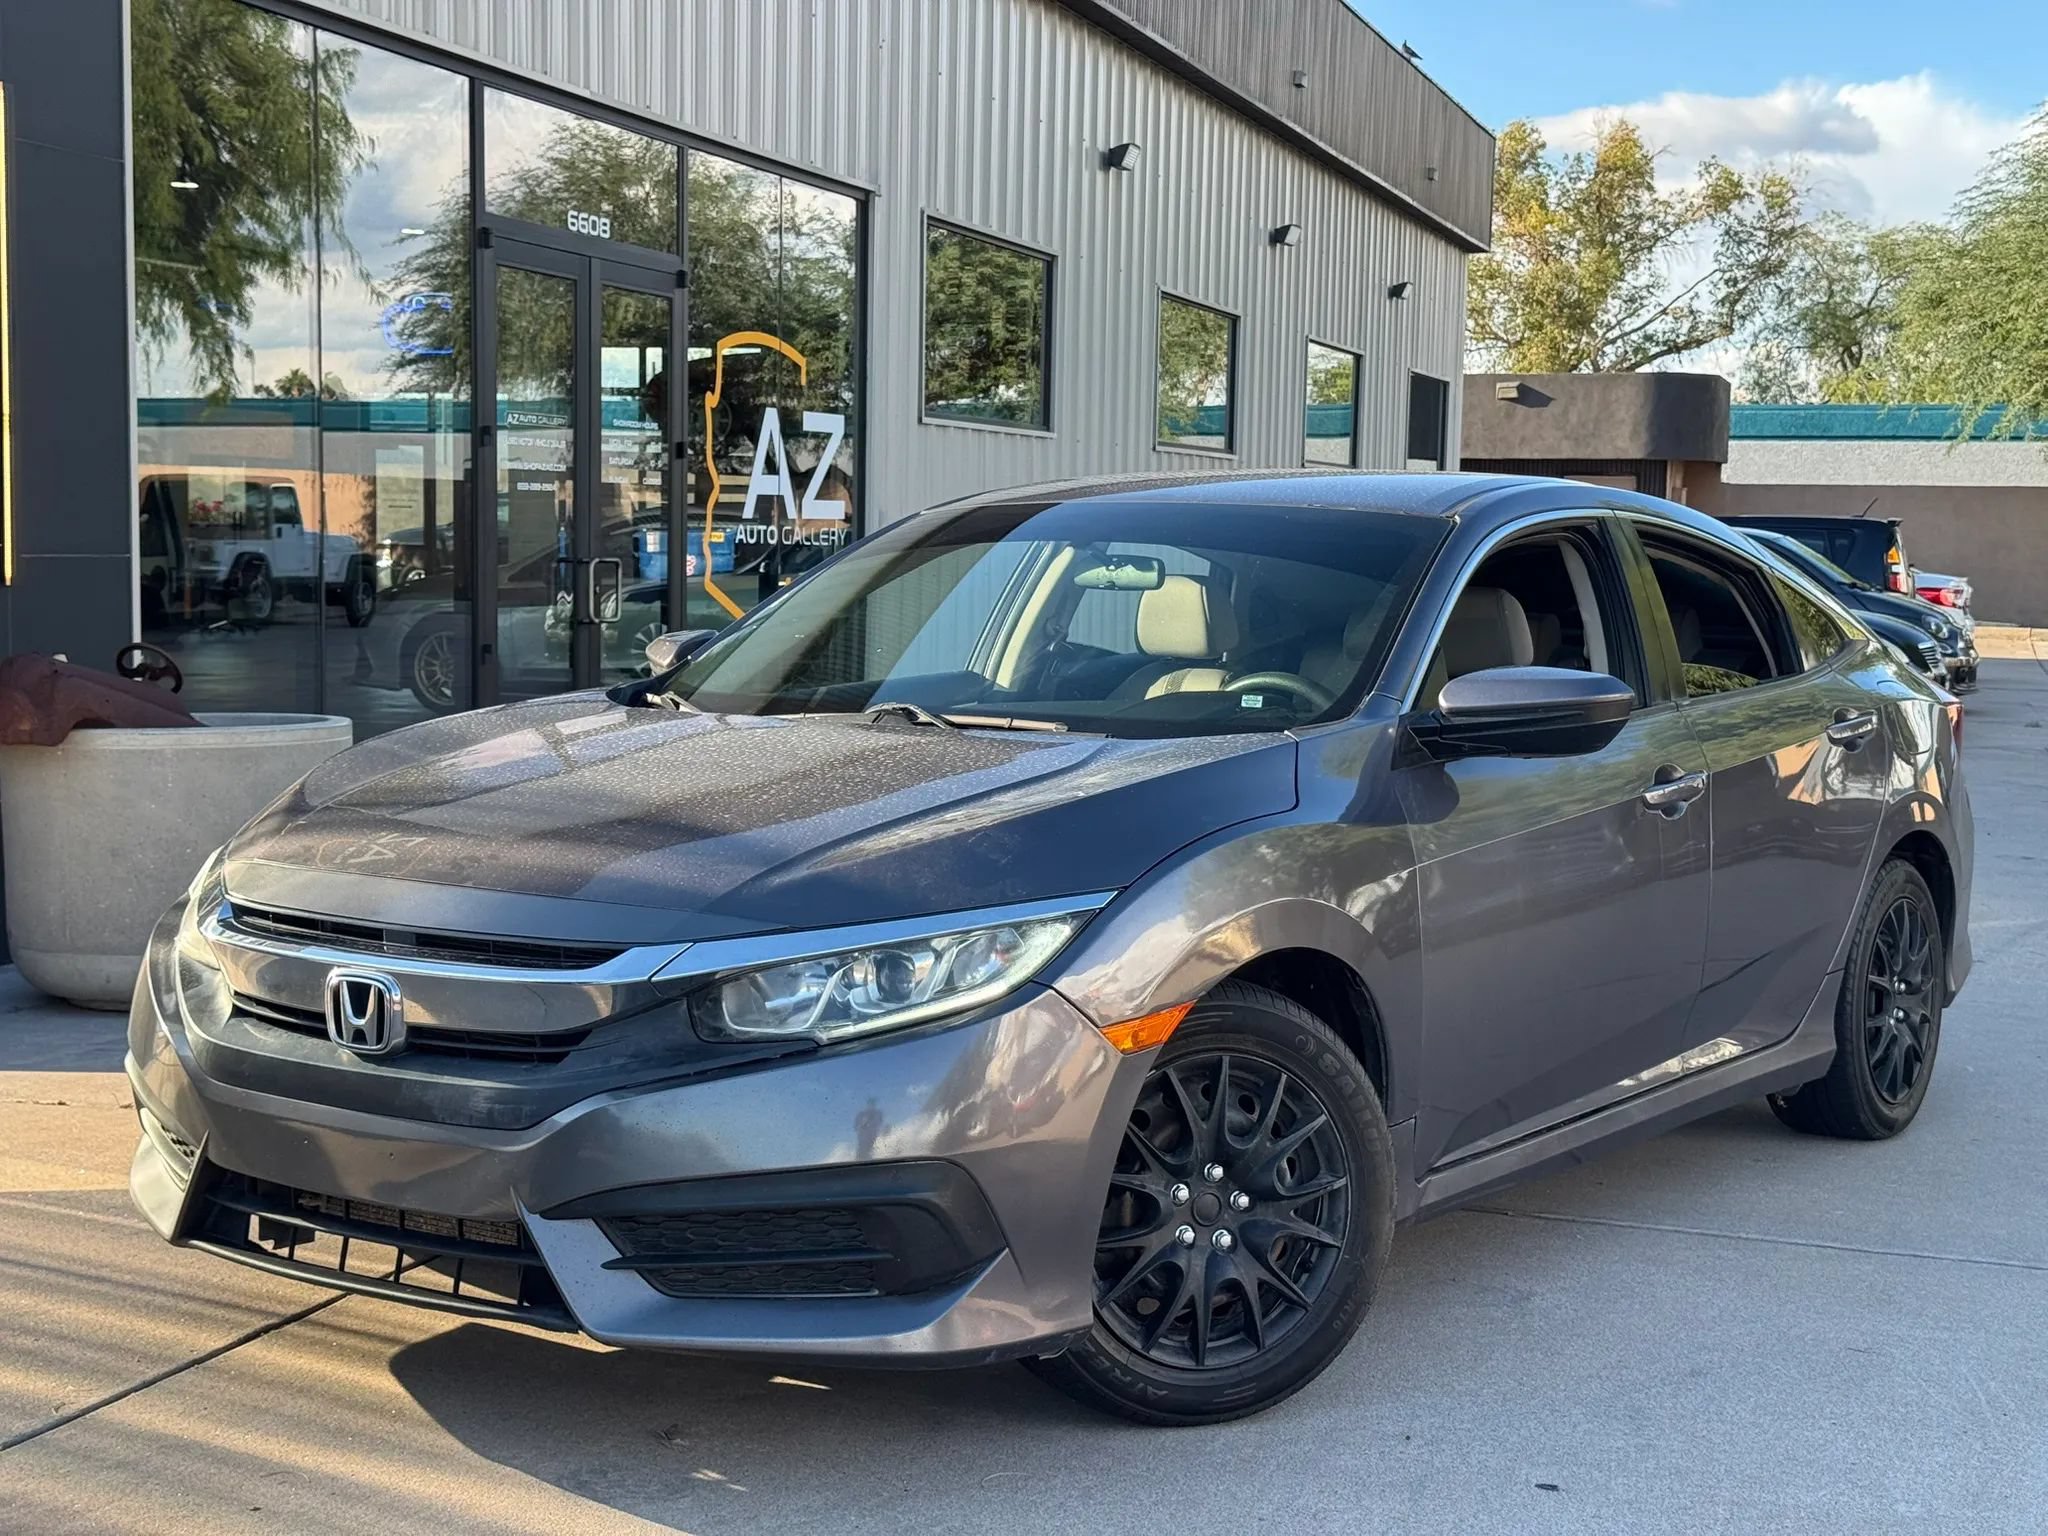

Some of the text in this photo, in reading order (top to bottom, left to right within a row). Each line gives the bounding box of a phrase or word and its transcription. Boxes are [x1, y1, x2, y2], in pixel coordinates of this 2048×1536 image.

[567, 209, 611, 239] 6608
[742, 406, 846, 520] AZ
[734, 523, 779, 546] AUTO
[781, 525, 847, 547] GALLERY
